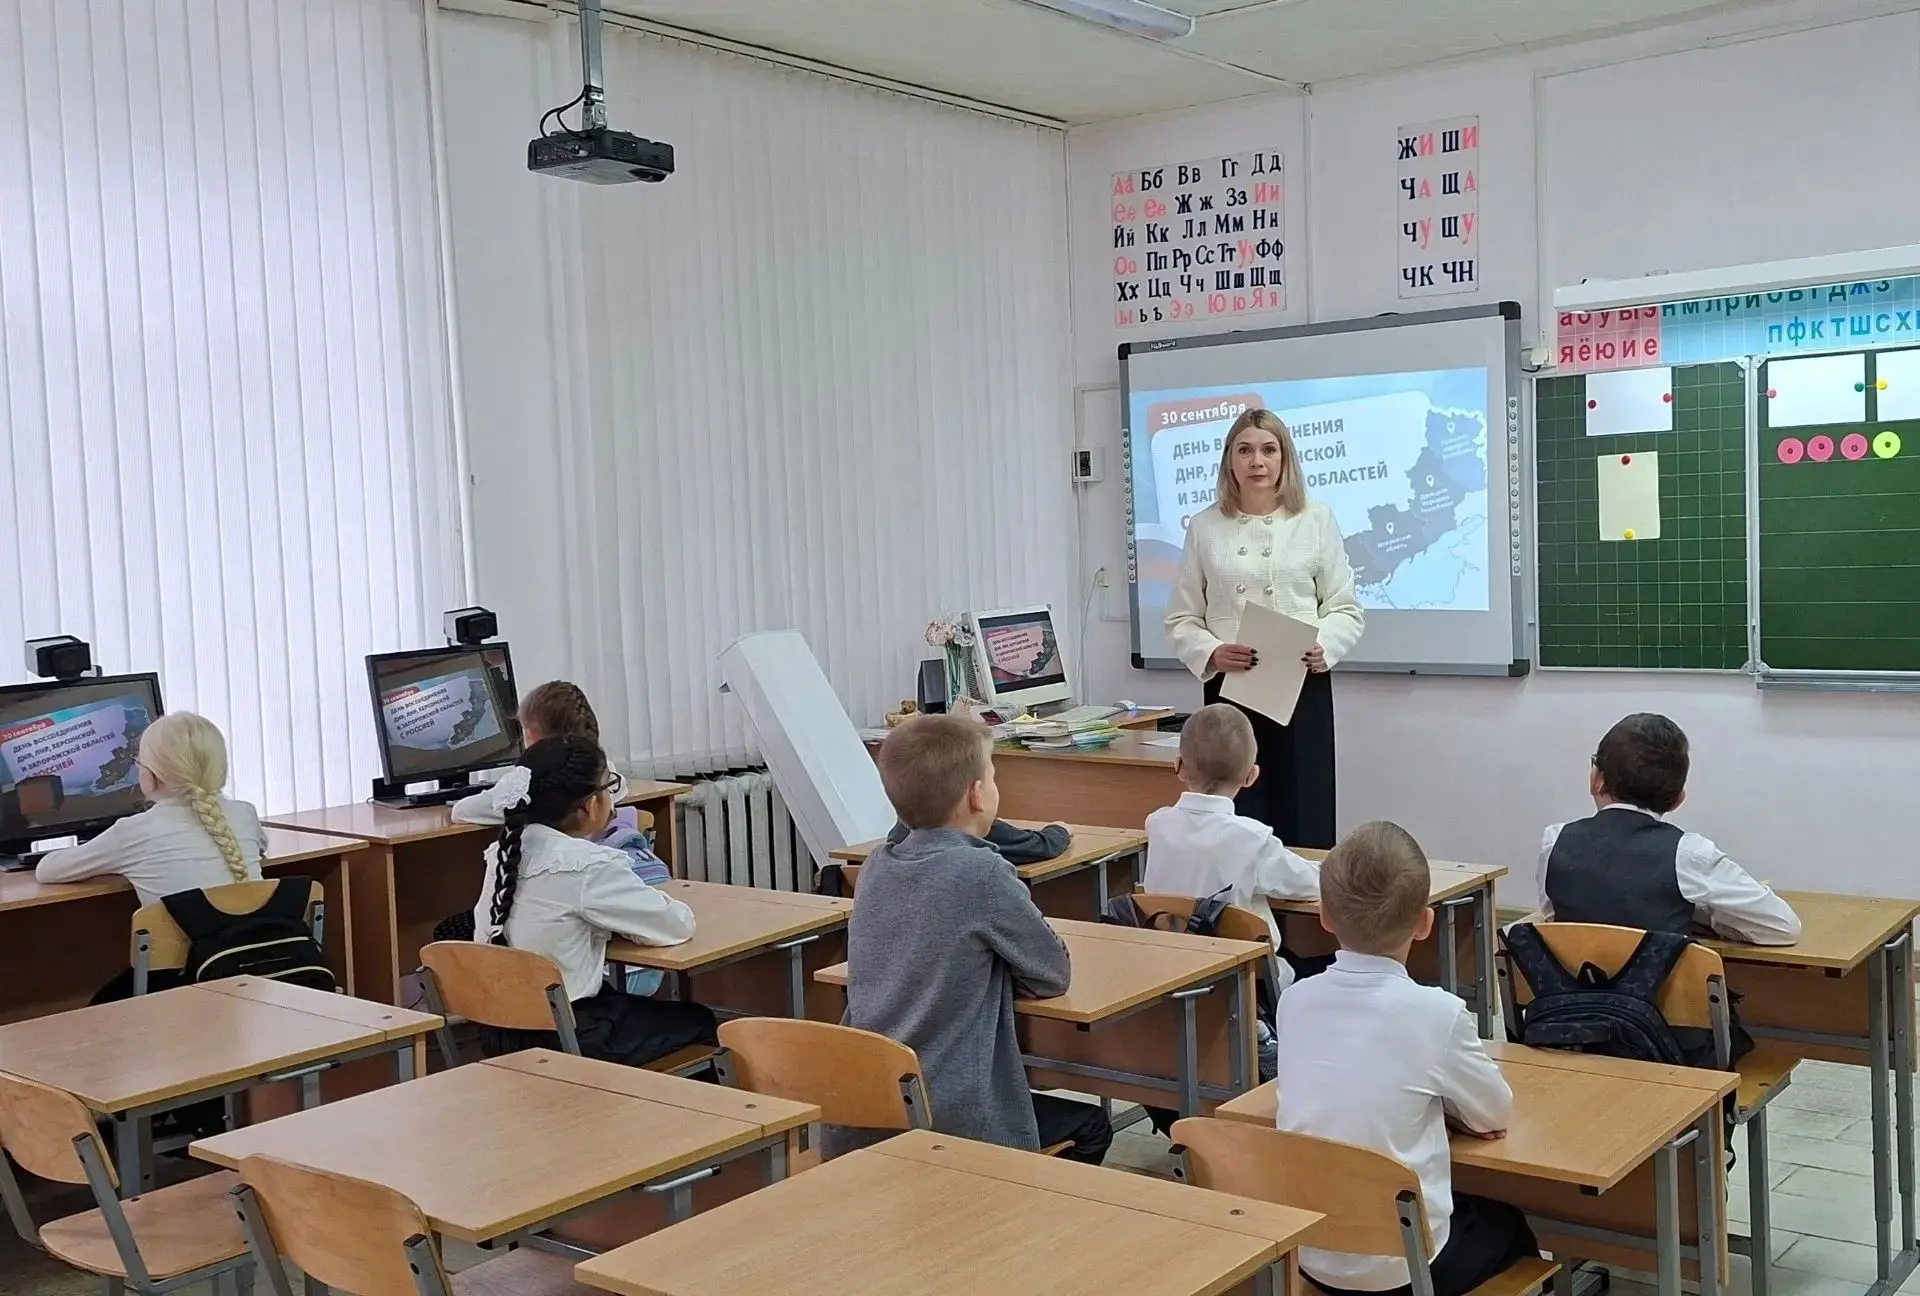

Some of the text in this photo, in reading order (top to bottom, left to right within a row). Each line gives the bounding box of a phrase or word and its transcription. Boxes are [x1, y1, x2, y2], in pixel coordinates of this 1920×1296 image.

[1398, 126, 1477, 160] ЖИ ШИ
[1141, 169, 1163, 191] Бб
[1178, 165, 1201, 185] Вв
[1221, 158, 1239, 178] Гг
[1400, 170, 1476, 200] ЧА ЩА
[1226, 187, 1247, 207] Зз
[1146, 223, 1169, 244] Кк
[1215, 214, 1244, 234] Мм
[1252, 209, 1278, 230] Нн
[1403, 213, 1475, 249] ЧУ ЩУ
[1146, 252, 1167, 272] Пп
[1172, 249, 1191, 272] Рр
[1195, 245, 1214, 265] Сс
[1217, 243, 1236, 263] Тт
[1256, 238, 1284, 260] Фф
[1117, 281, 1139, 302] Хх
[1215, 270, 1244, 290] Шш
[1402, 260, 1474, 288] ЧК ЧН
[1161, 401, 1246, 425] 30 сентября
[1173, 440, 1211, 460] ДЕНЬ
[1176, 466, 1207, 484] ДНР,
[1178, 492, 1188, 506] И
[1307, 461, 1388, 488] ОБЛАСТЕЙ
[13, 741, 32, 754] ДЕНЬ
